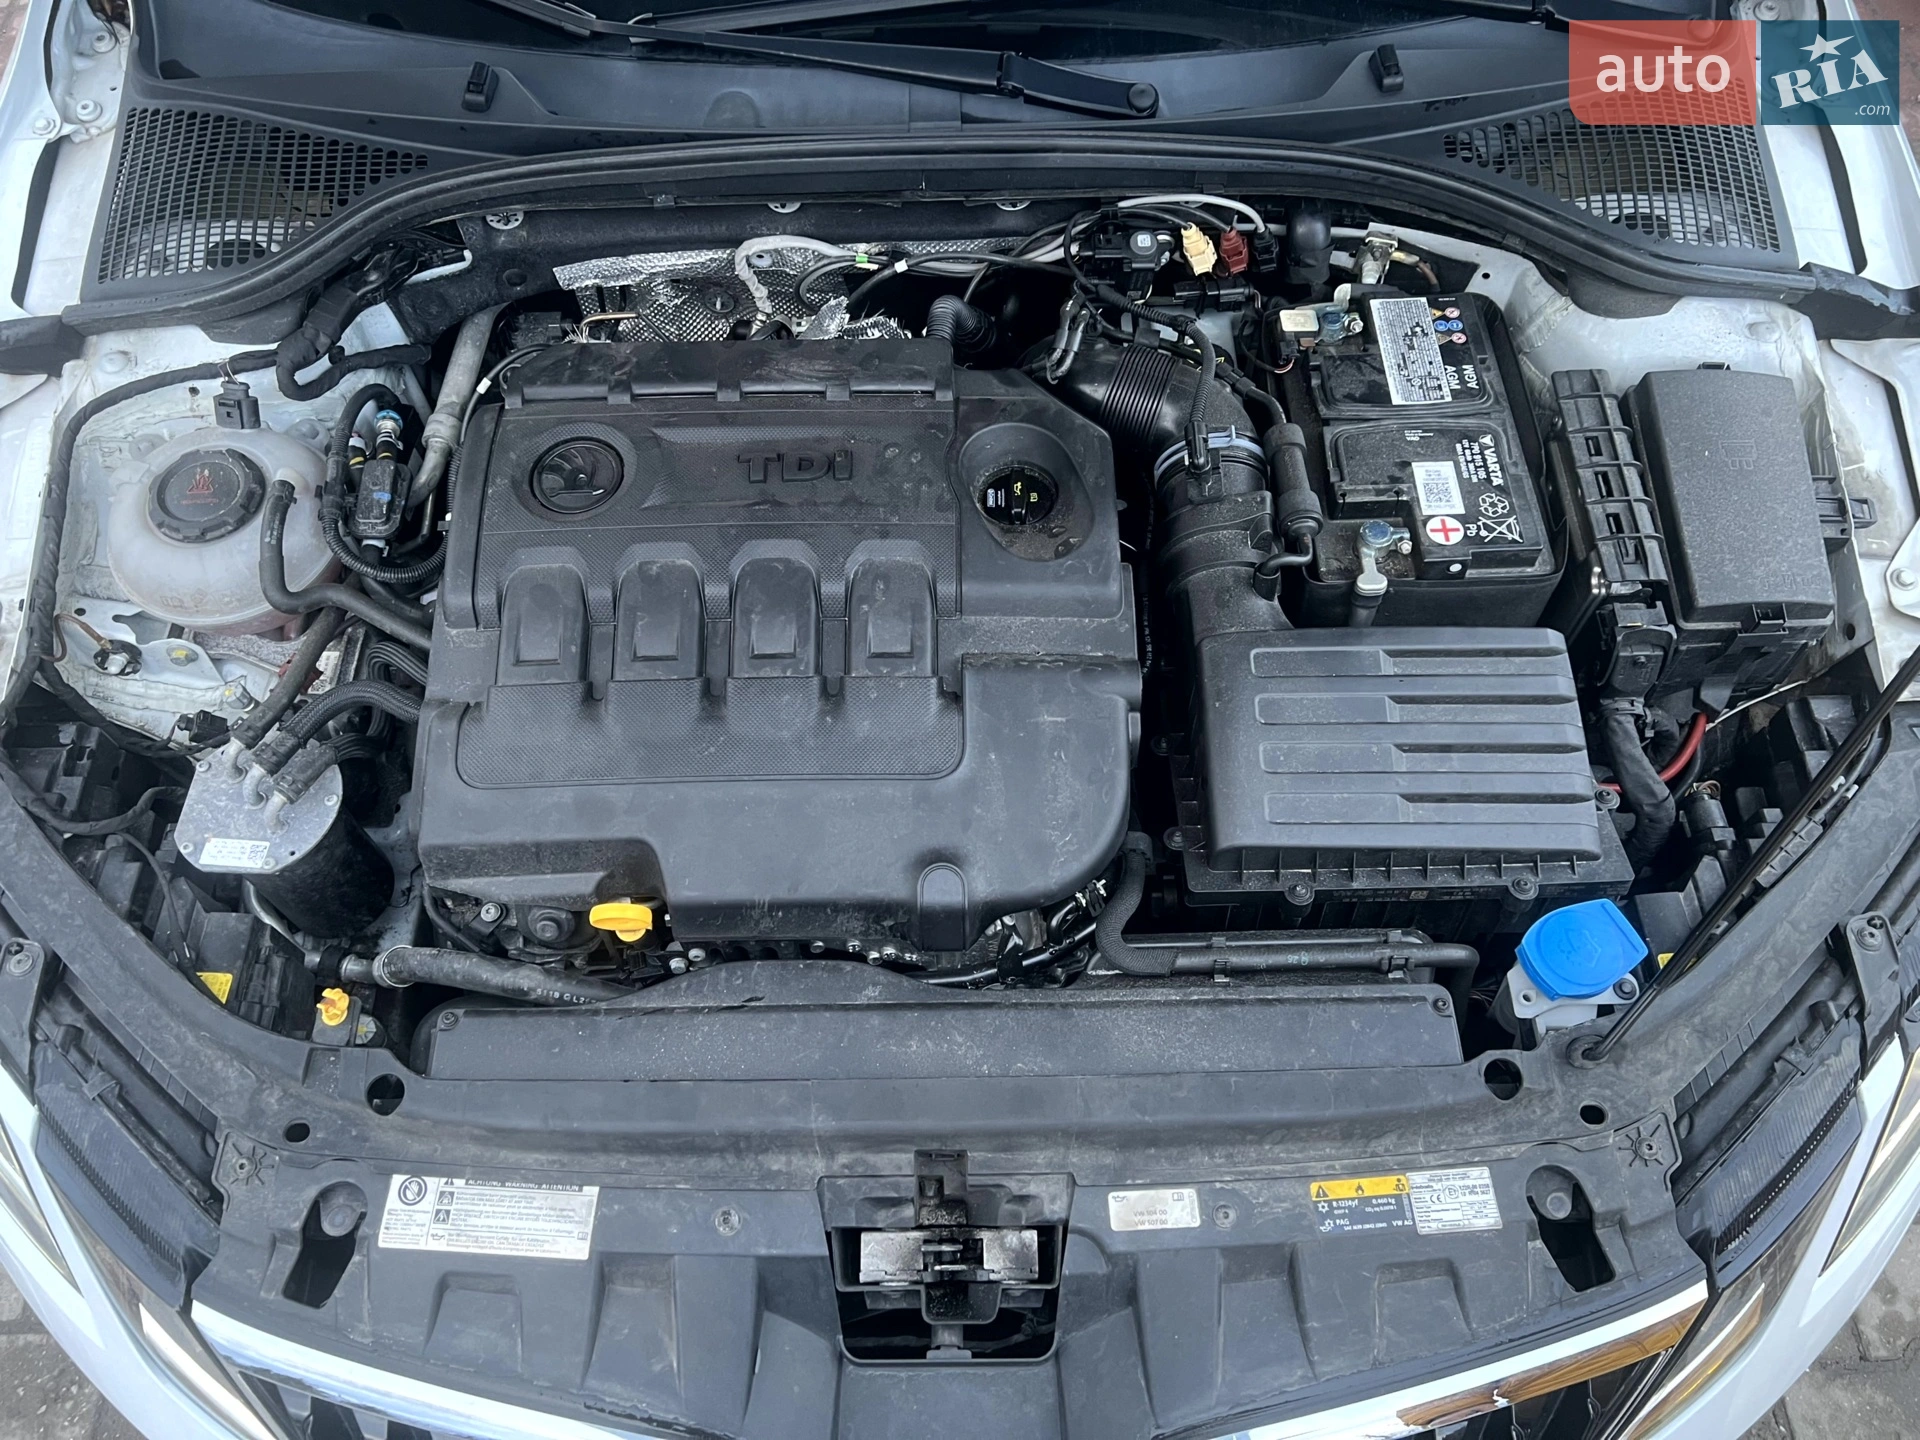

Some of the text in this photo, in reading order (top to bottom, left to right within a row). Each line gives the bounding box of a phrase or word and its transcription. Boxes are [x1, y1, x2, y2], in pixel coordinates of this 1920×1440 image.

[1444, 365, 1461, 389] AGM
[1462, 364, 1479, 389] AGM
[1473, 455, 1484, 466] 915
[1476, 467, 1487, 479] 105
[1484, 447, 1503, 487] VARTA
[1465, 524, 1477, 537] Pb
[1332, 1199, 1359, 1208] R-1234yf
[1336, 1218, 1350, 1226] PAG
